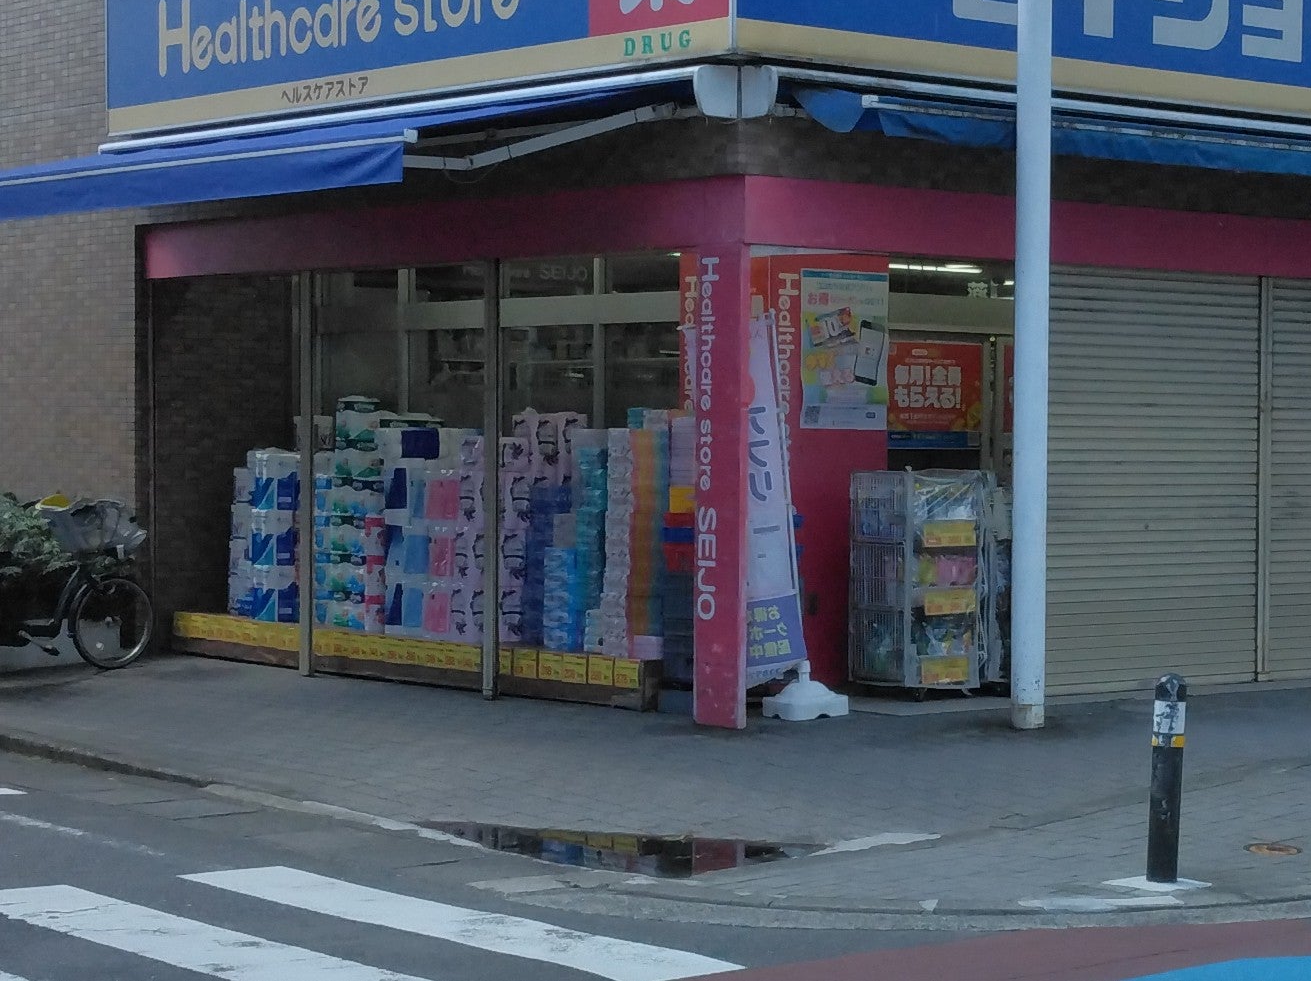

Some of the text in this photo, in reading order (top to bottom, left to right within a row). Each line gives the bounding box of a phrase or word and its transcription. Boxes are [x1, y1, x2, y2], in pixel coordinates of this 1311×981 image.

[623, 29, 693, 57] DRUG
[281, 77, 369, 104] ヘルスケアストア
[697, 257, 720, 620] Healthcare store SEIJO
